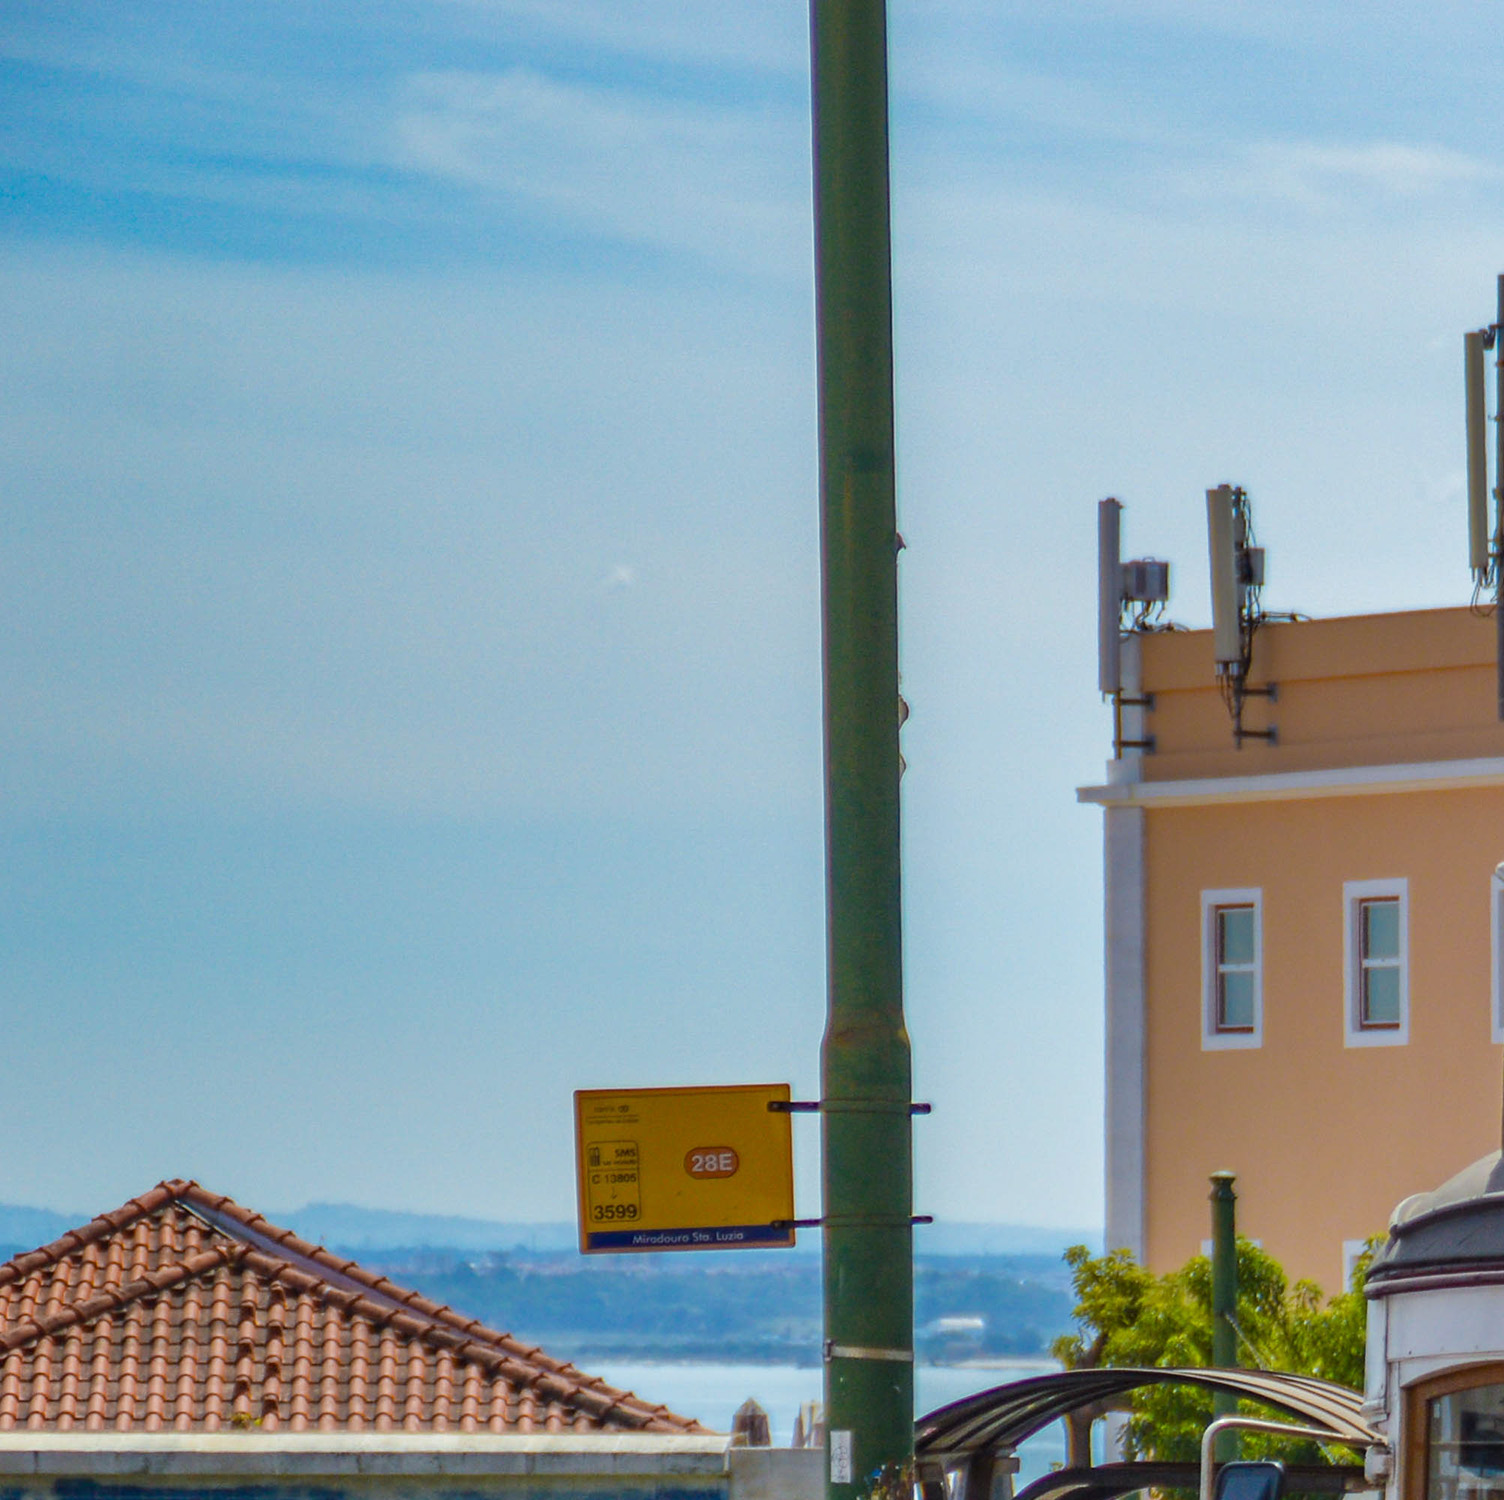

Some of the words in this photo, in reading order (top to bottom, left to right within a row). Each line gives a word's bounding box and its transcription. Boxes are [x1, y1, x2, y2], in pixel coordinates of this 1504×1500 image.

[691, 1153, 733, 1172] 28E
[594, 1204, 637, 1220] 3599
[633, 1231, 689, 1245] Miradouro
[716, 1231, 744, 1242] Luzia
